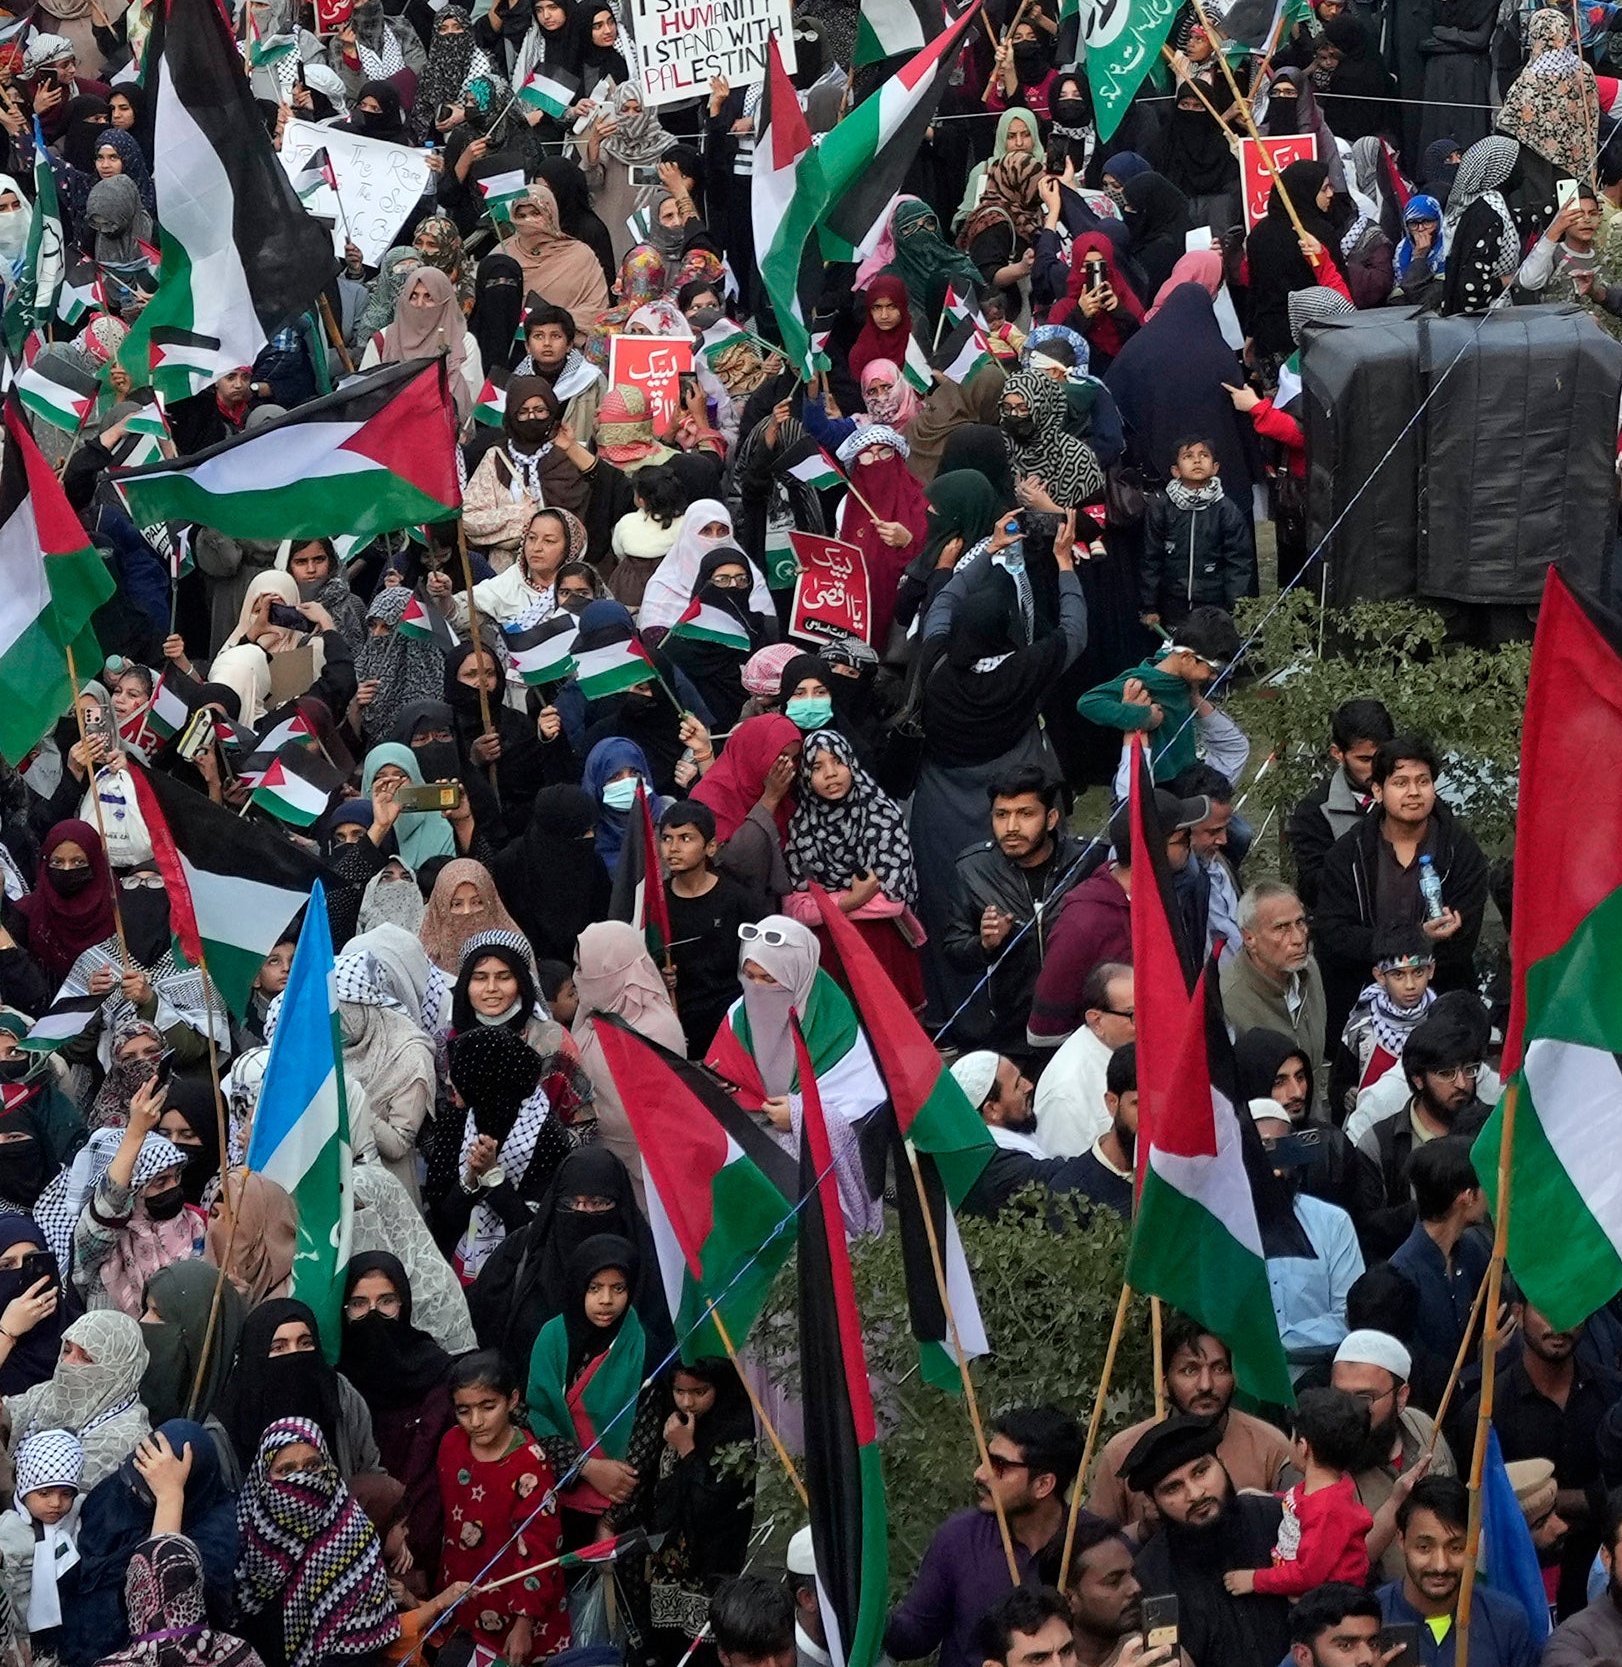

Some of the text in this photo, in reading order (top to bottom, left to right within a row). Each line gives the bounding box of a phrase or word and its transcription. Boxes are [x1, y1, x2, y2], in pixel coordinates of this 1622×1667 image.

[642, 14, 784, 68] I STAND WITH
[644, 42, 767, 95] PALESTIN
